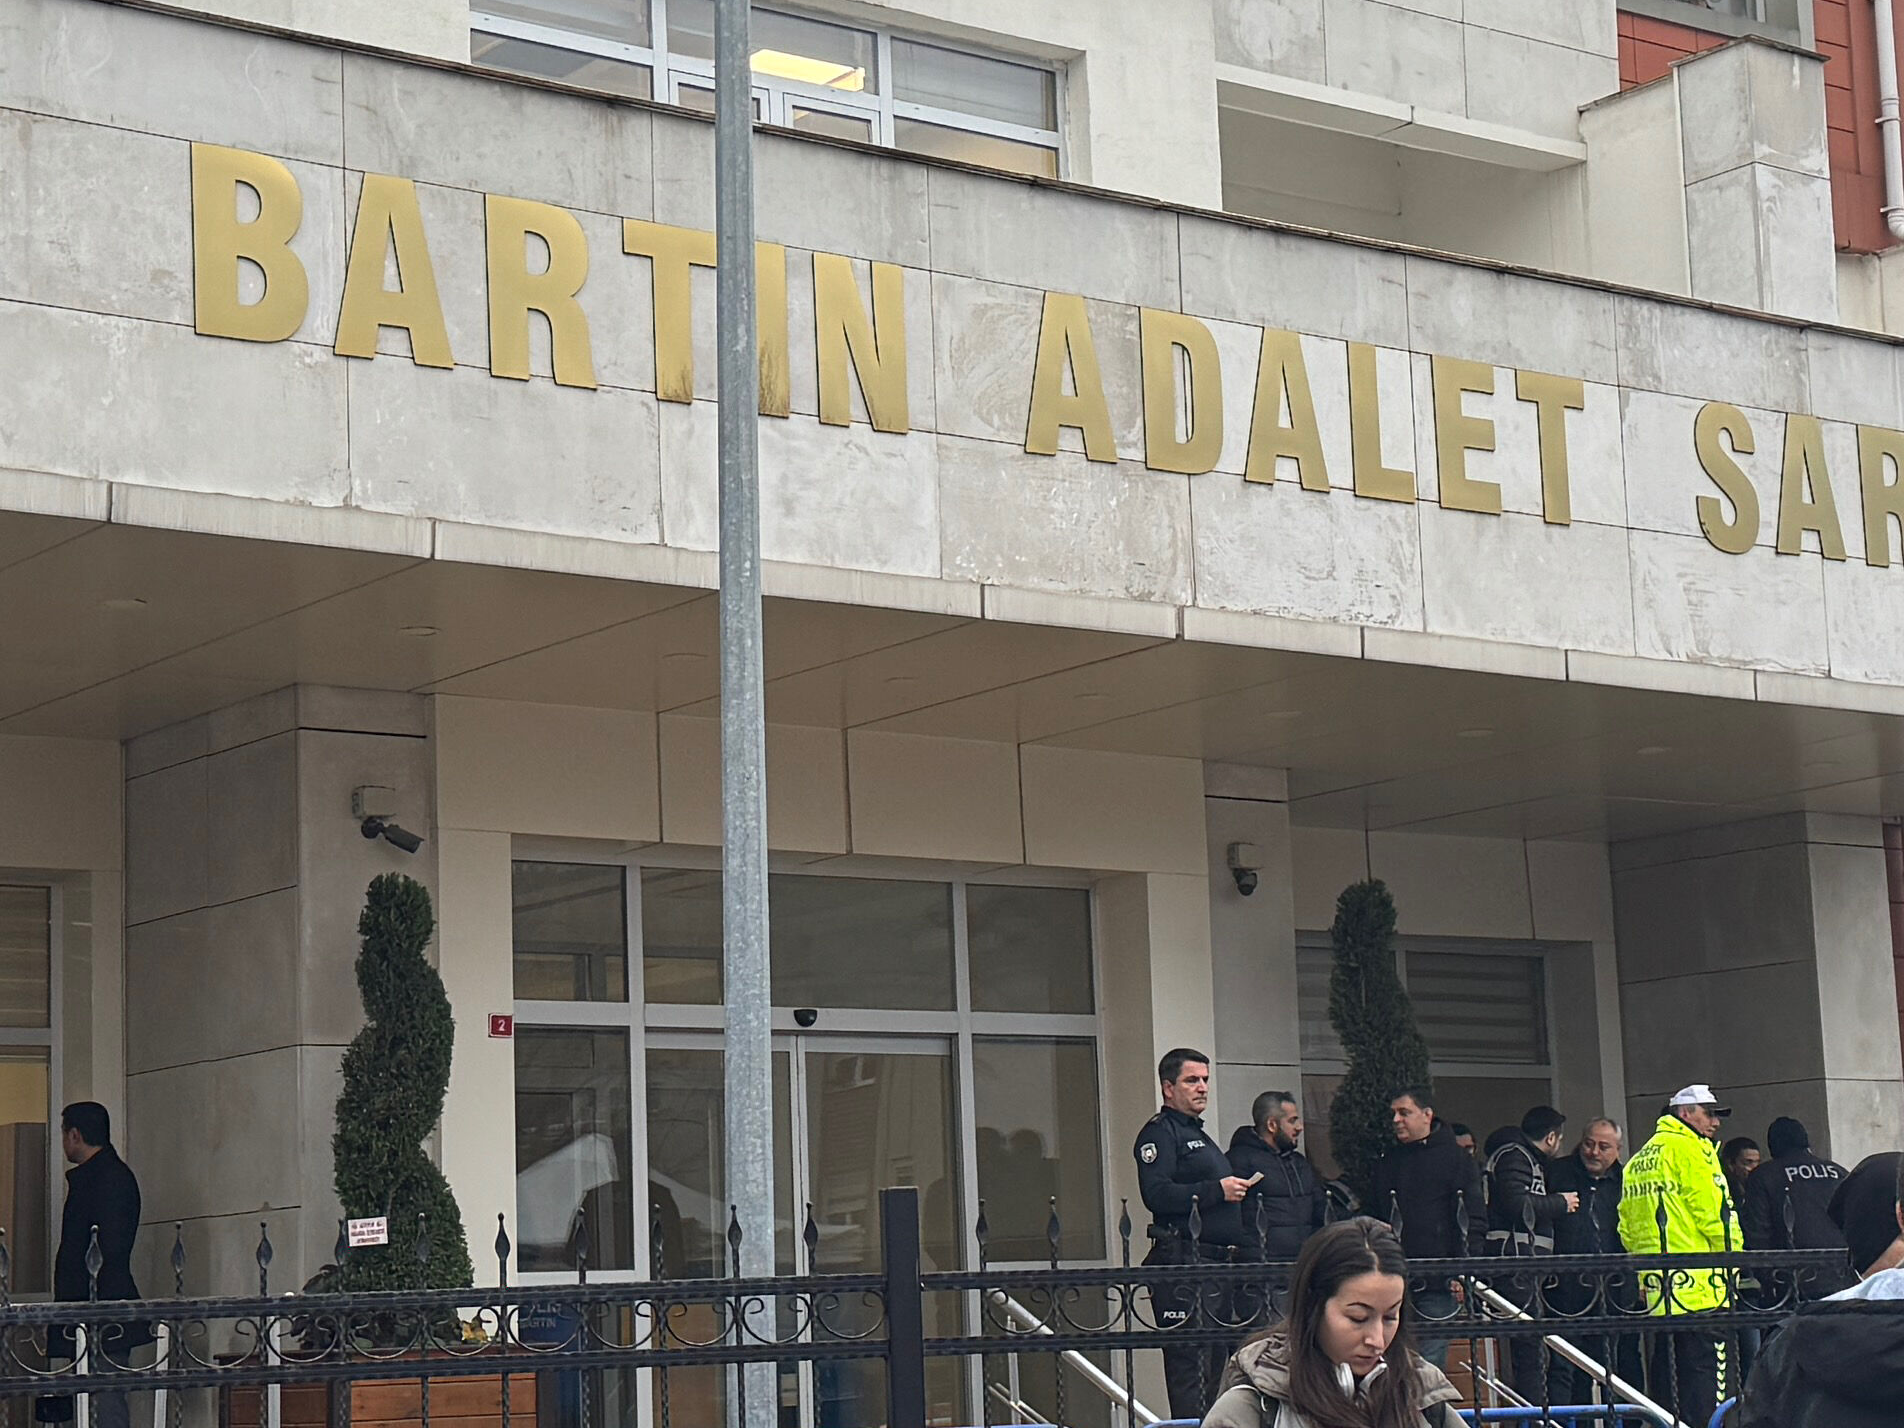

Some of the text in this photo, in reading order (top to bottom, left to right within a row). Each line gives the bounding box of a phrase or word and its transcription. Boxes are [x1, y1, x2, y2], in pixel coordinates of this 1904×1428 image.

[190, 139, 909, 435] BARTIN
[1022, 289, 1585, 526] ADALET
[498, 1019, 506, 1032] 2
[1784, 1164, 1839, 1182] POLIS
